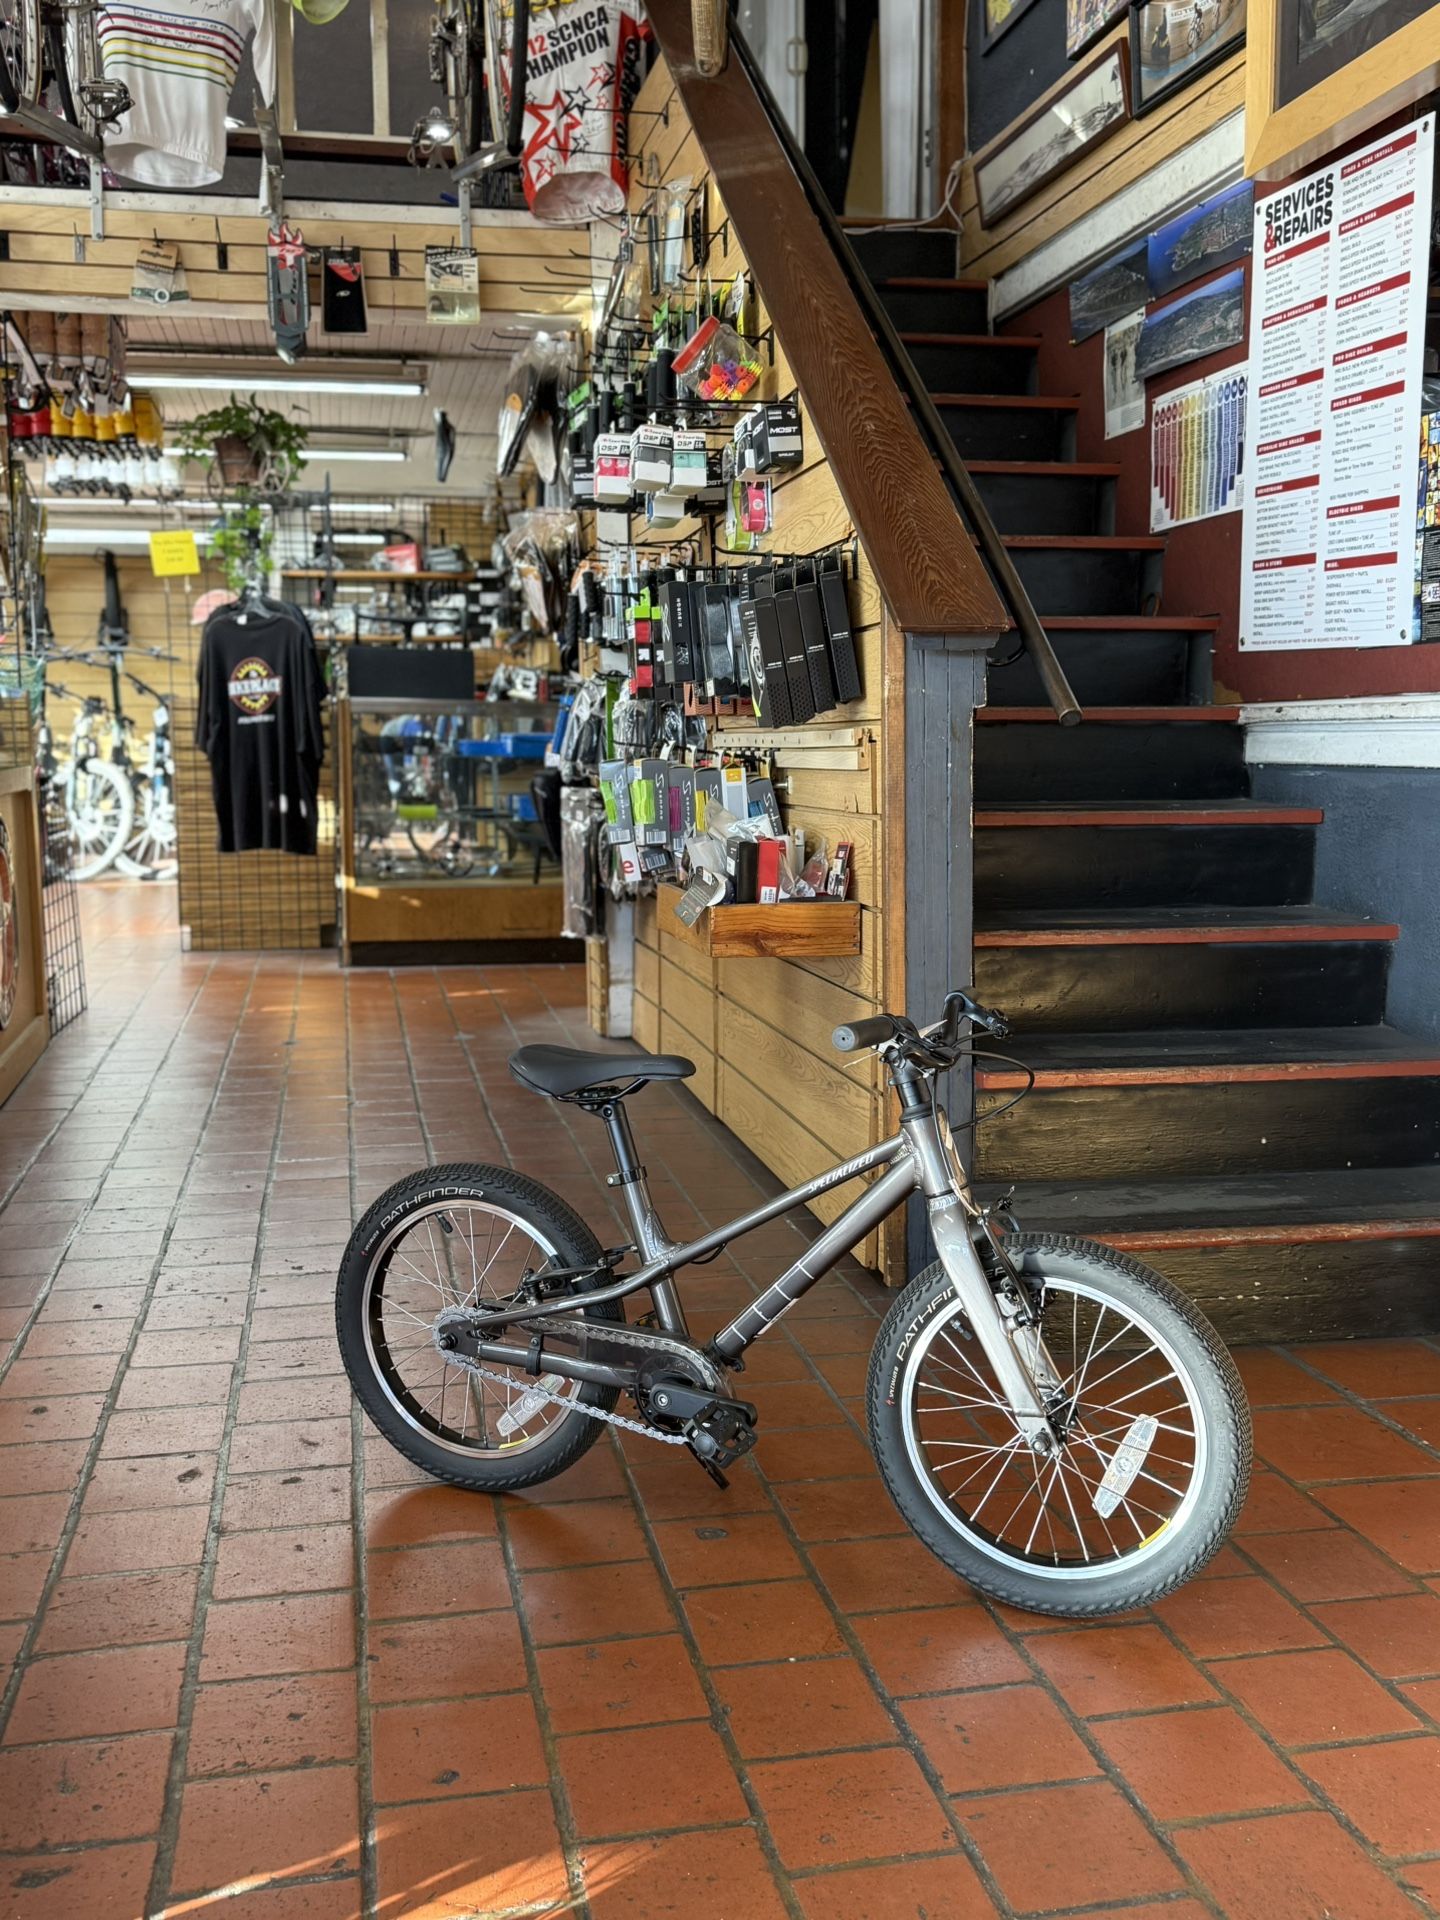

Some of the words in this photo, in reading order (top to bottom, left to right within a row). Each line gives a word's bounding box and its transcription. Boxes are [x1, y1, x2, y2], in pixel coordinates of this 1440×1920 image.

[528, 34, 548, 57] 12
[547, 5, 610, 48] SCNCA
[526, 26, 610, 82] HAMPION
[1265, 173, 1334, 226] SERVICES
[1341, 219, 1358, 231] WHEELS
[1364, 211, 1376, 221] HUBS
[1264, 223, 1277, 253] &
[1274, 200, 1333, 247] REPAIRS
[1338, 296, 1352, 305] FORKS
[1357, 285, 1380, 298] HEADSETS
[769, 426, 798, 434] MOST
[1329, 507, 1348, 515] ELECTRIC
[808, 1152, 875, 1194] SPECIALIZED
[380, 1186, 484, 1230] PATHFINDER
